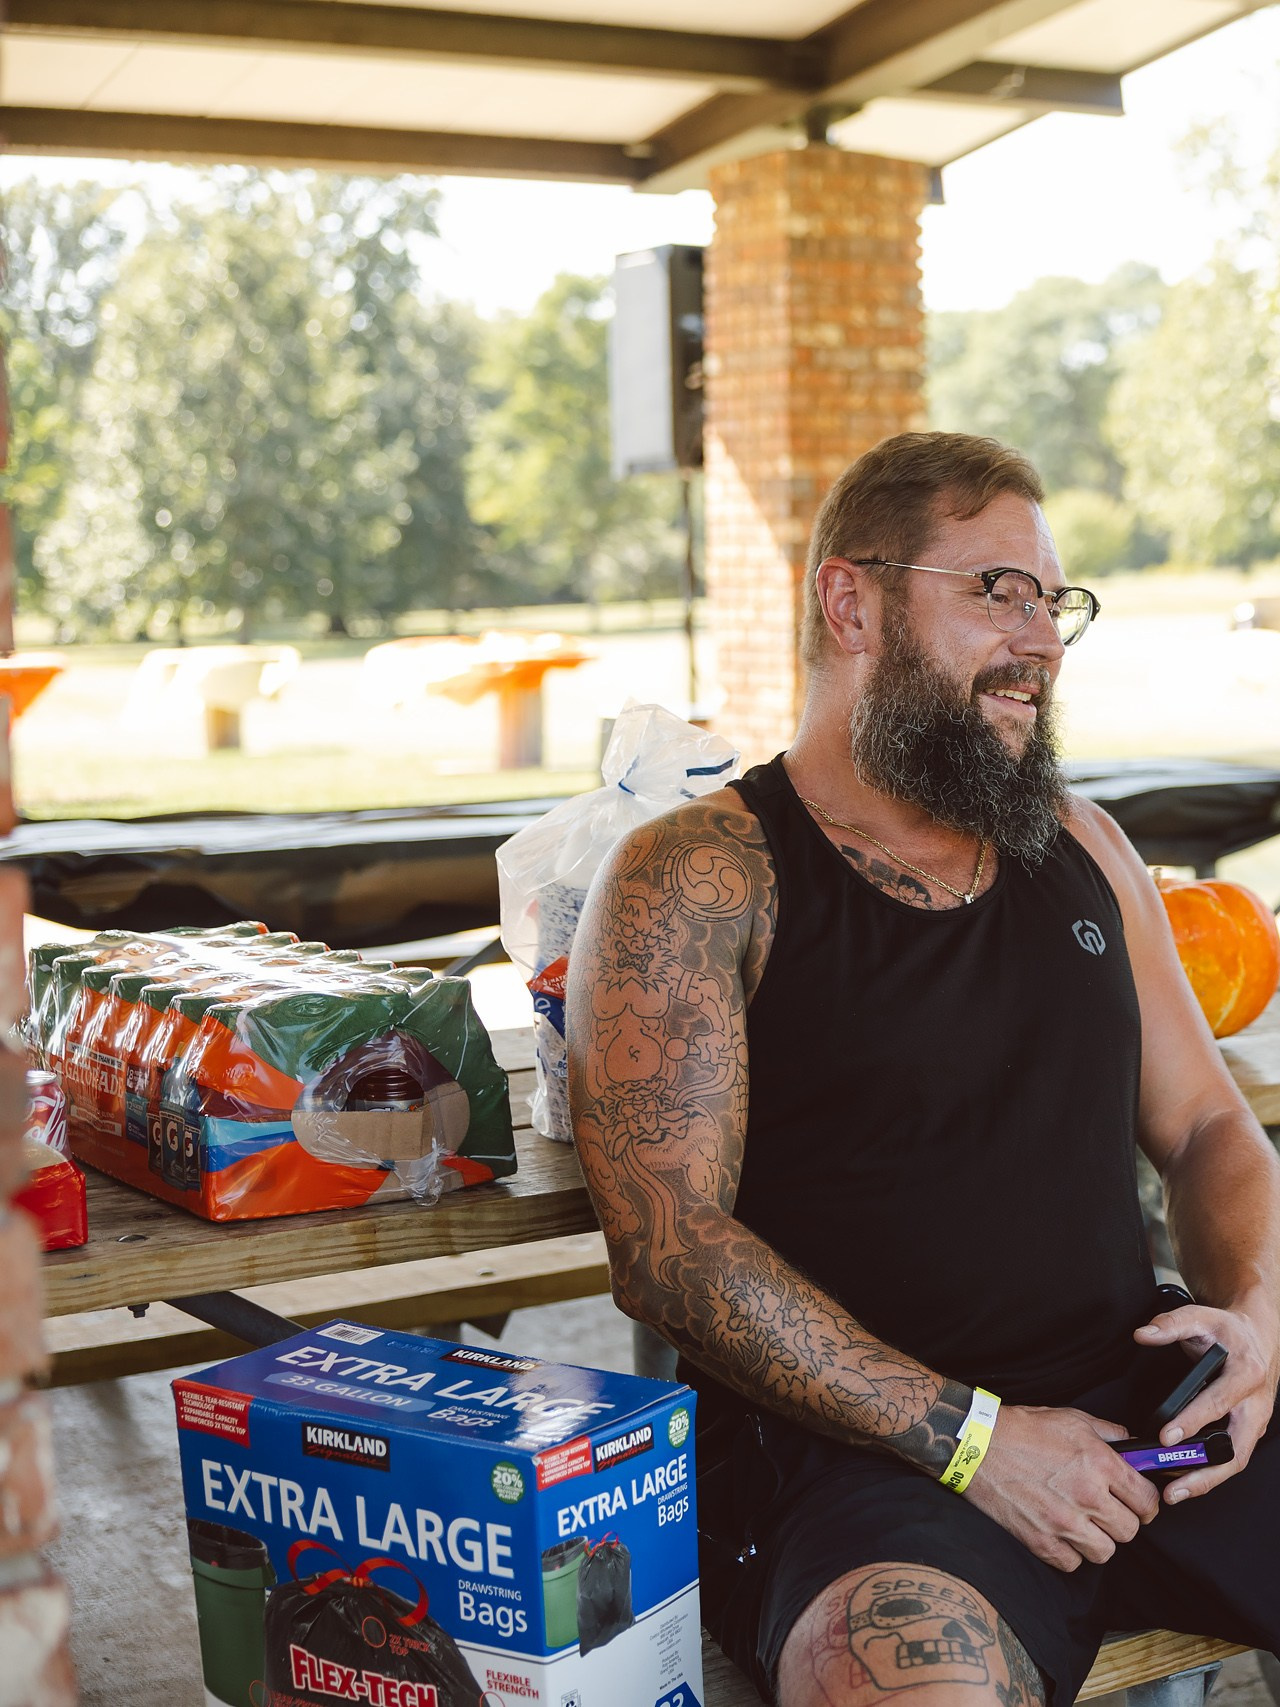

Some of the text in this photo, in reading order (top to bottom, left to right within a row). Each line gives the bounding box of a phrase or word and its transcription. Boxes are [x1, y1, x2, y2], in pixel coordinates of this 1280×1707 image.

[64, 1058, 125, 1098] GATORADE
[166, 1120, 178, 1152] G
[452, 1349, 538, 1371] KIRKLAND
[275, 1346, 437, 1392] EXTRA
[434, 1380, 616, 1420] LARGE
[280, 1375, 413, 1408] 33 GALLON
[427, 1408, 501, 1428] Bags
[669, 1414, 689, 1434] 20%
[306, 1426, 387, 1457] KIRKLAND
[596, 1426, 652, 1462] KIRKLAND
[1158, 1449, 1198, 1462] BREEZE
[492, 1470, 523, 1488] 20%
[658, 1482, 688, 1505] DRAWSTRING
[557, 1453, 688, 1538] EXTRA LARGE
[201, 1458, 516, 1580] EXTRA LARGE
[658, 1496, 690, 1527] Bags
[458, 1580, 522, 1602] DRAWSTRING
[871, 1578, 978, 1612] SPEED
[458, 1591, 528, 1638] Bags
[289, 1643, 439, 1707] FLEX-TECH
[486, 1669, 531, 1688] FLEXIBLE
[486, 1680, 540, 1700] STRENGTH
